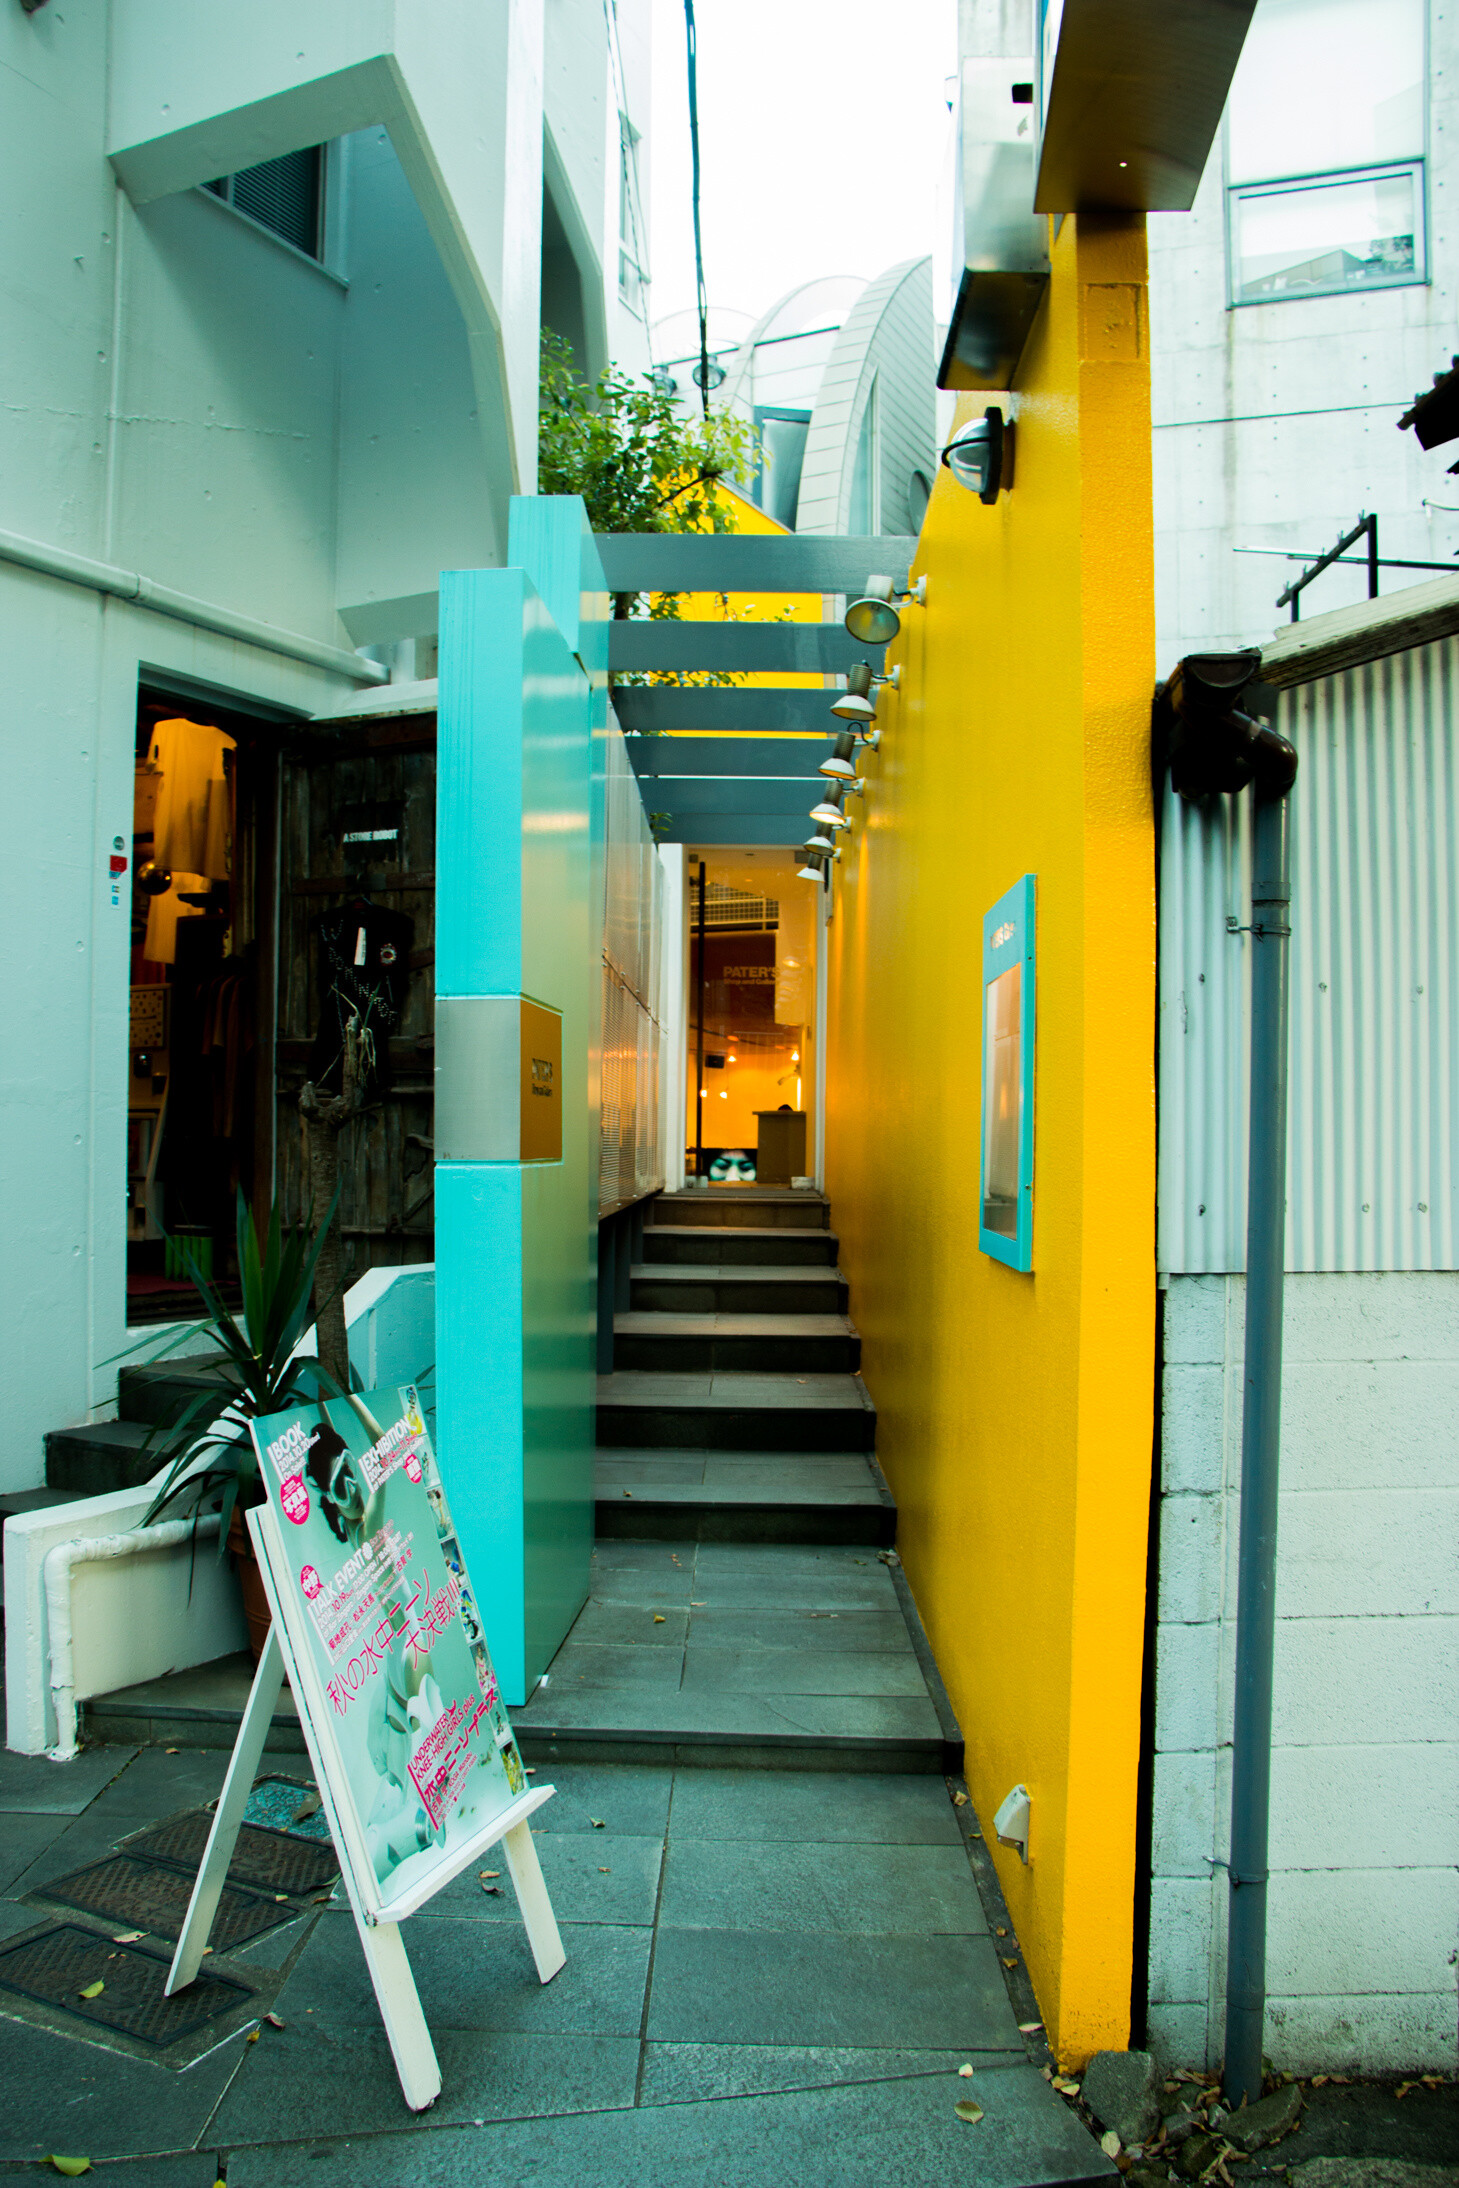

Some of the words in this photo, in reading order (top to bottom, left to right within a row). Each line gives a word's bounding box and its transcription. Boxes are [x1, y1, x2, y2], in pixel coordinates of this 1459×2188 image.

[349, 831, 373, 842] STORE
[723, 966, 780, 978] PATER'S
[271, 1420, 306, 1460] BOOK
[362, 1414, 414, 1472] EXHIBITION
[310, 1579, 338, 1618] TALK
[334, 1547, 366, 1592] EVENT
[326, 1569, 430, 1717] 秋の水中ニーソ
[410, 1712, 449, 1771] UNDERWATER
[415, 1731, 447, 1781] KNEE-HIGH
[445, 1707, 464, 1737] GIRLS
[463, 1694, 475, 1716] plus
[424, 1687, 498, 1802] 水中ニーソプラス
